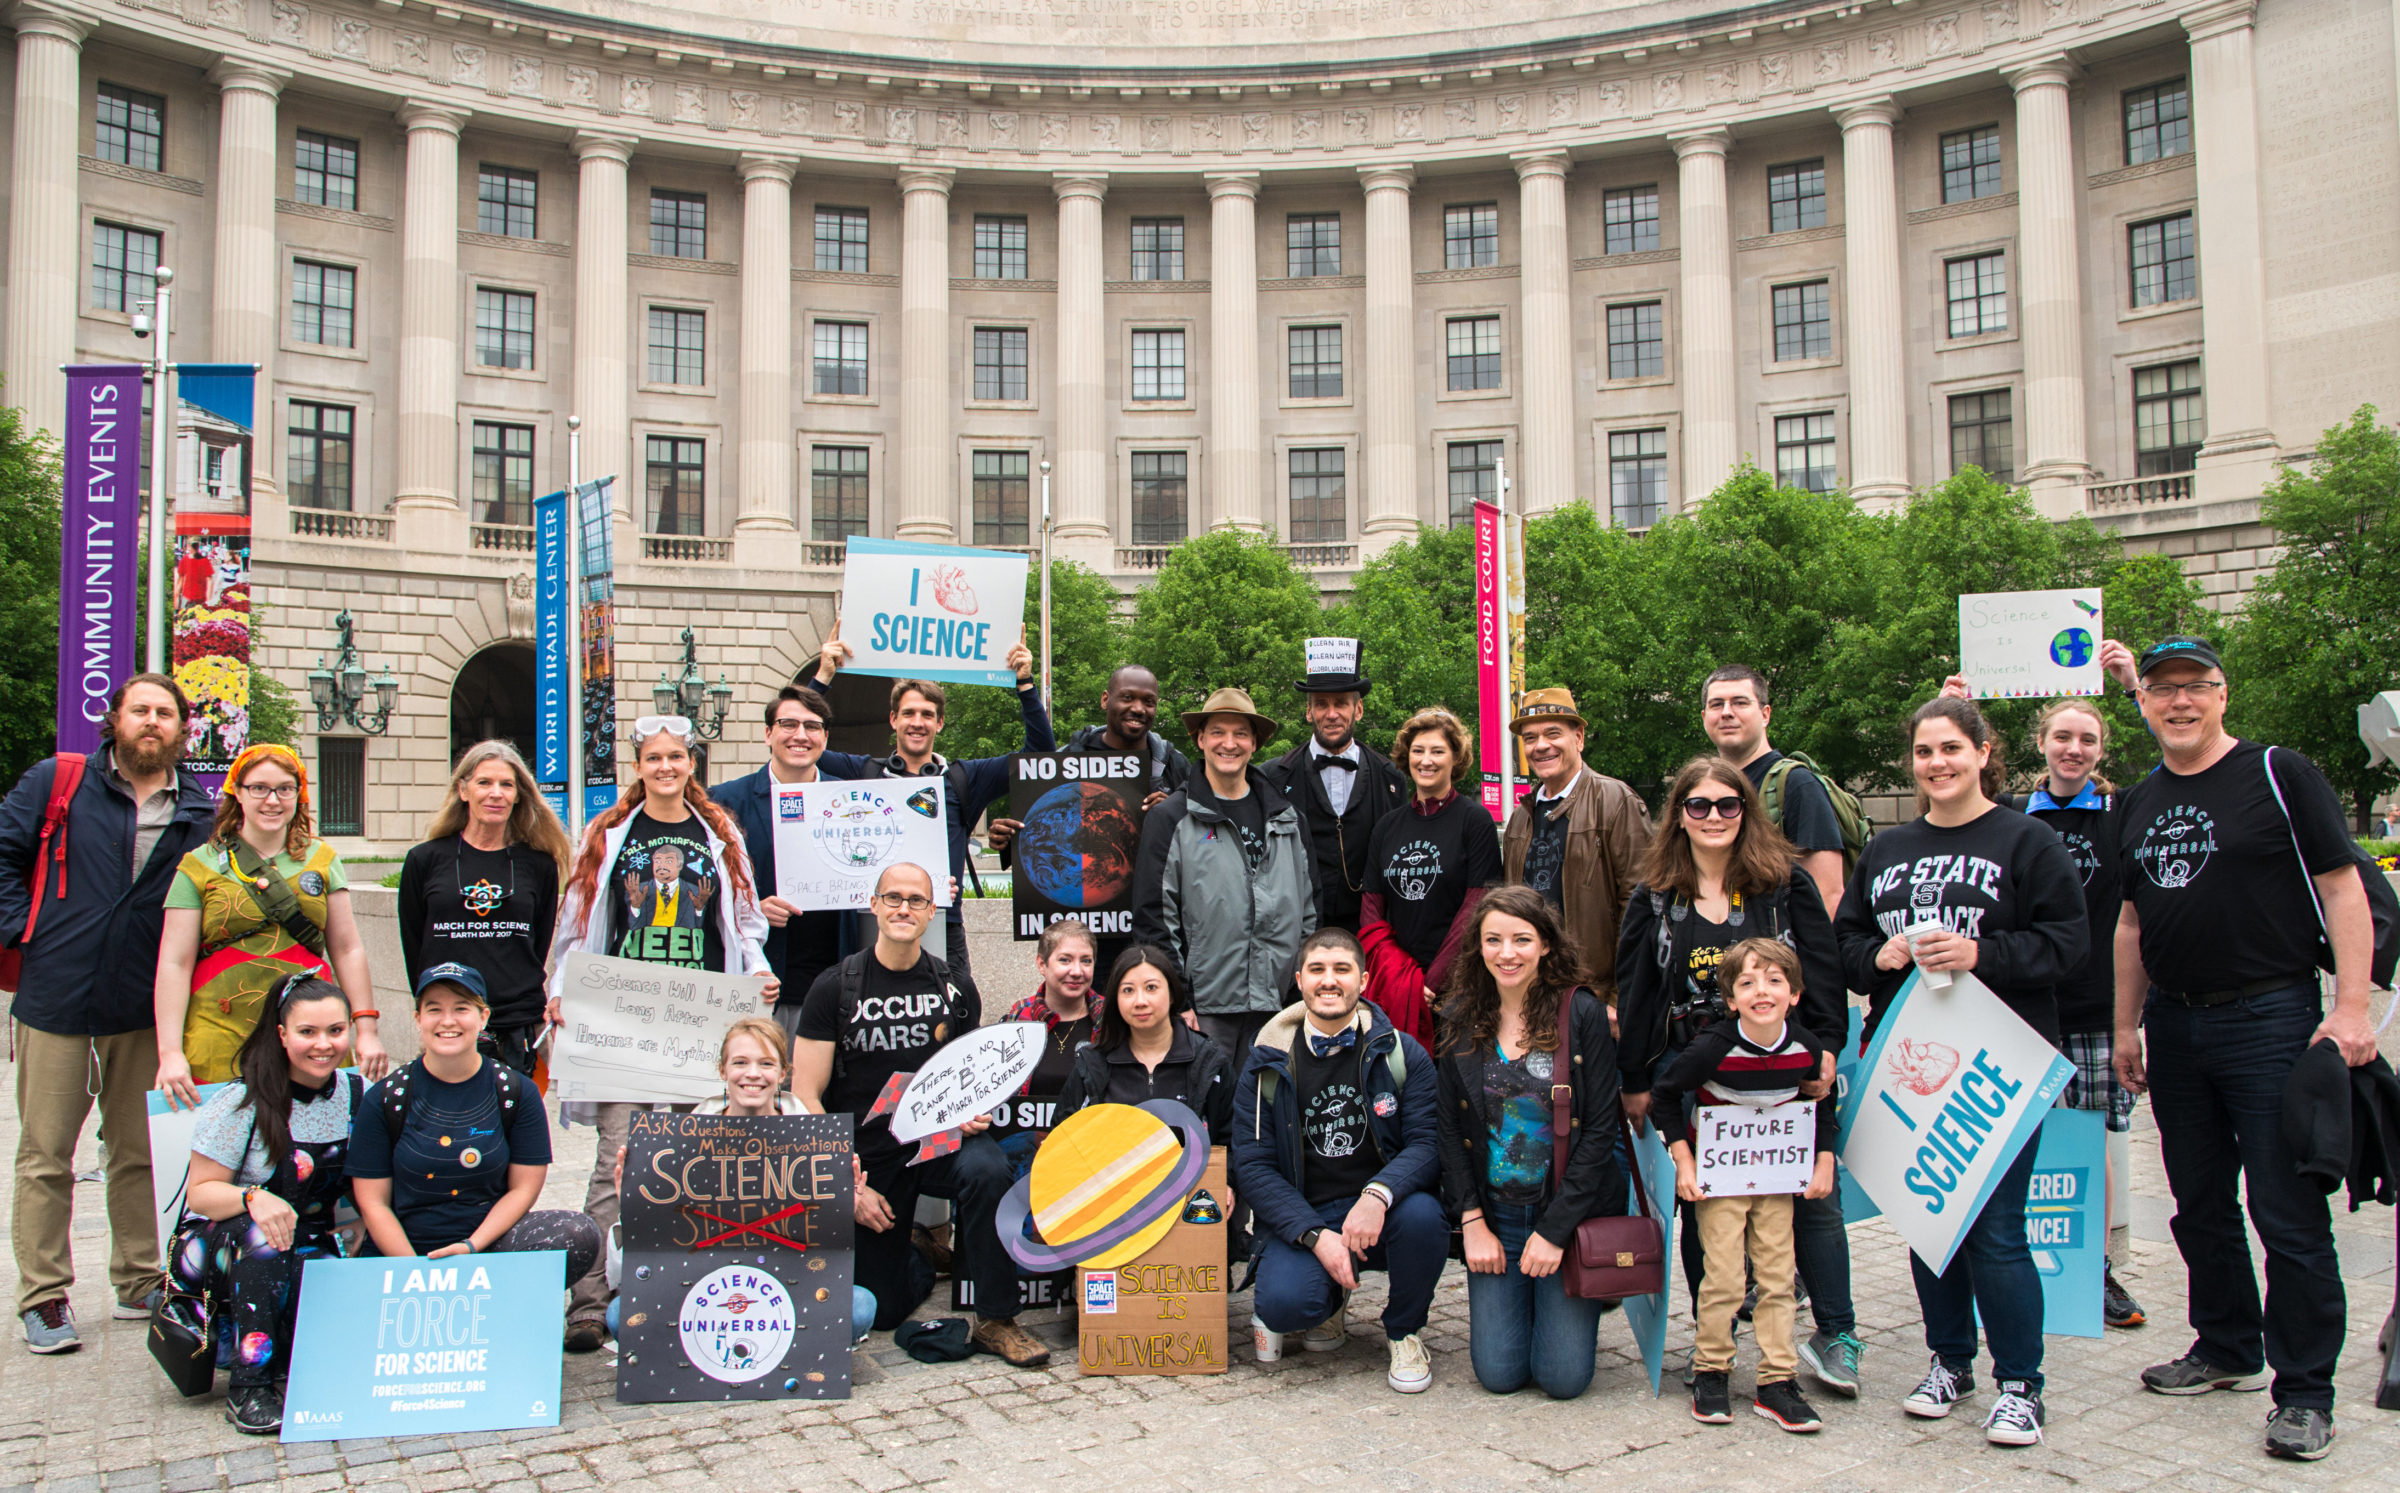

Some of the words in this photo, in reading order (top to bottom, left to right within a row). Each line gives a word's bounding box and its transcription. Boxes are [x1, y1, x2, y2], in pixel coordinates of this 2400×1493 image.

[1052, 14, 1078, 28] TO
[1091, 15, 1124, 29] ALL
[1136, 15, 1183, 29] WHO
[1198, 14, 1265, 29] LISTEN
[1279, 12, 1318, 27] FOR
[1067, 0, 1134, 13] TRUMP
[88, 384, 118, 503] EVENTS
[545, 508, 558, 601] CENTER
[1481, 516, 1491, 594] COURT
[909, 568, 920, 606] I
[82, 514, 114, 723] COMMUNITY
[1969, 599, 2050, 628] Science
[545, 606, 558, 680] TRADE
[870, 612, 991, 661] SCIENCE
[1482, 601, 1494, 667] FOOD
[1963, 660, 2032, 677] Universal
[1018, 757, 1056, 781] NO
[1062, 755, 1141, 780] SIDES
[593, 795, 608, 806] GSA
[781, 799, 803, 809] SPACE
[823, 791, 894, 819] SCIENCE
[812, 825, 903, 840] UNIVERSAL
[2147, 805, 2215, 837] SCIENCE
[618, 842, 646, 862] Y'ALL
[1392, 840, 1440, 861] SCIENCE
[2135, 840, 2219, 860] UNIVERSAL
[1384, 865, 1443, 878] UNIVERSAL
[1871, 862, 1908, 907] NC
[1909, 855, 2002, 902] STATE
[784, 879, 821, 896] SPACE
[828, 878, 869, 892] BRINGS
[824, 896, 840, 906] IN
[850, 892, 868, 905] US!
[433, 921, 465, 931] MARCH
[467, 921, 489, 930] FOR
[492, 921, 530, 931] SCIENCE
[1020, 913, 1044, 936] IN
[619, 926, 704, 960] NEED
[579, 963, 662, 995] Science
[706, 986, 722, 1008] be
[727, 989, 757, 1014] Real
[614, 997, 656, 1024] Long
[664, 1004, 710, 1028] After
[576, 1023, 633, 1049] Humans
[637, 1039, 658, 1053] are
[842, 1022, 930, 1052] MARS
[911, 1066, 955, 1094] THERE
[962, 1053, 973, 1066] IS
[979, 1040, 994, 1055] NO
[973, 1081, 991, 1102] FOR
[991, 1058, 1027, 1090] SCIENCE
[911, 1086, 951, 1122] PLANET
[992, 1102, 1011, 1127] O
[1304, 1084, 1364, 1117] SCIENCE
[1879, 1089, 1917, 1132] I
[631, 1113, 675, 1136] Ask
[1715, 1120, 1794, 1141] FUTURE
[1903, 1047, 2023, 1215] SCIENCE
[700, 1139, 740, 1156] Make
[752, 1136, 850, 1156] Observations
[1702, 1146, 1808, 1169] SCIENTIST
[639, 1149, 836, 1204] SCIENCE
[673, 1203, 821, 1247] SILENCE
[382, 1270, 394, 1294] I
[402, 1268, 458, 1293] AM
[467, 1266, 492, 1290] A
[696, 1274, 782, 1308] SCIENCE
[1088, 1283, 1113, 1294] SPACE
[1119, 1264, 1220, 1296] SCIENCE
[377, 1294, 492, 1349] FORCE
[1156, 1296, 1188, 1320] IS
[682, 1319, 791, 1333] UNIVERSAL
[374, 1353, 410, 1377] FOR
[413, 1349, 488, 1375] SCIENCE
[1082, 1332, 1224, 1369] UNIVERSAL
[309, 1410, 343, 1424] AAAS
[390, 1397, 466, 1413] #Force4Science
